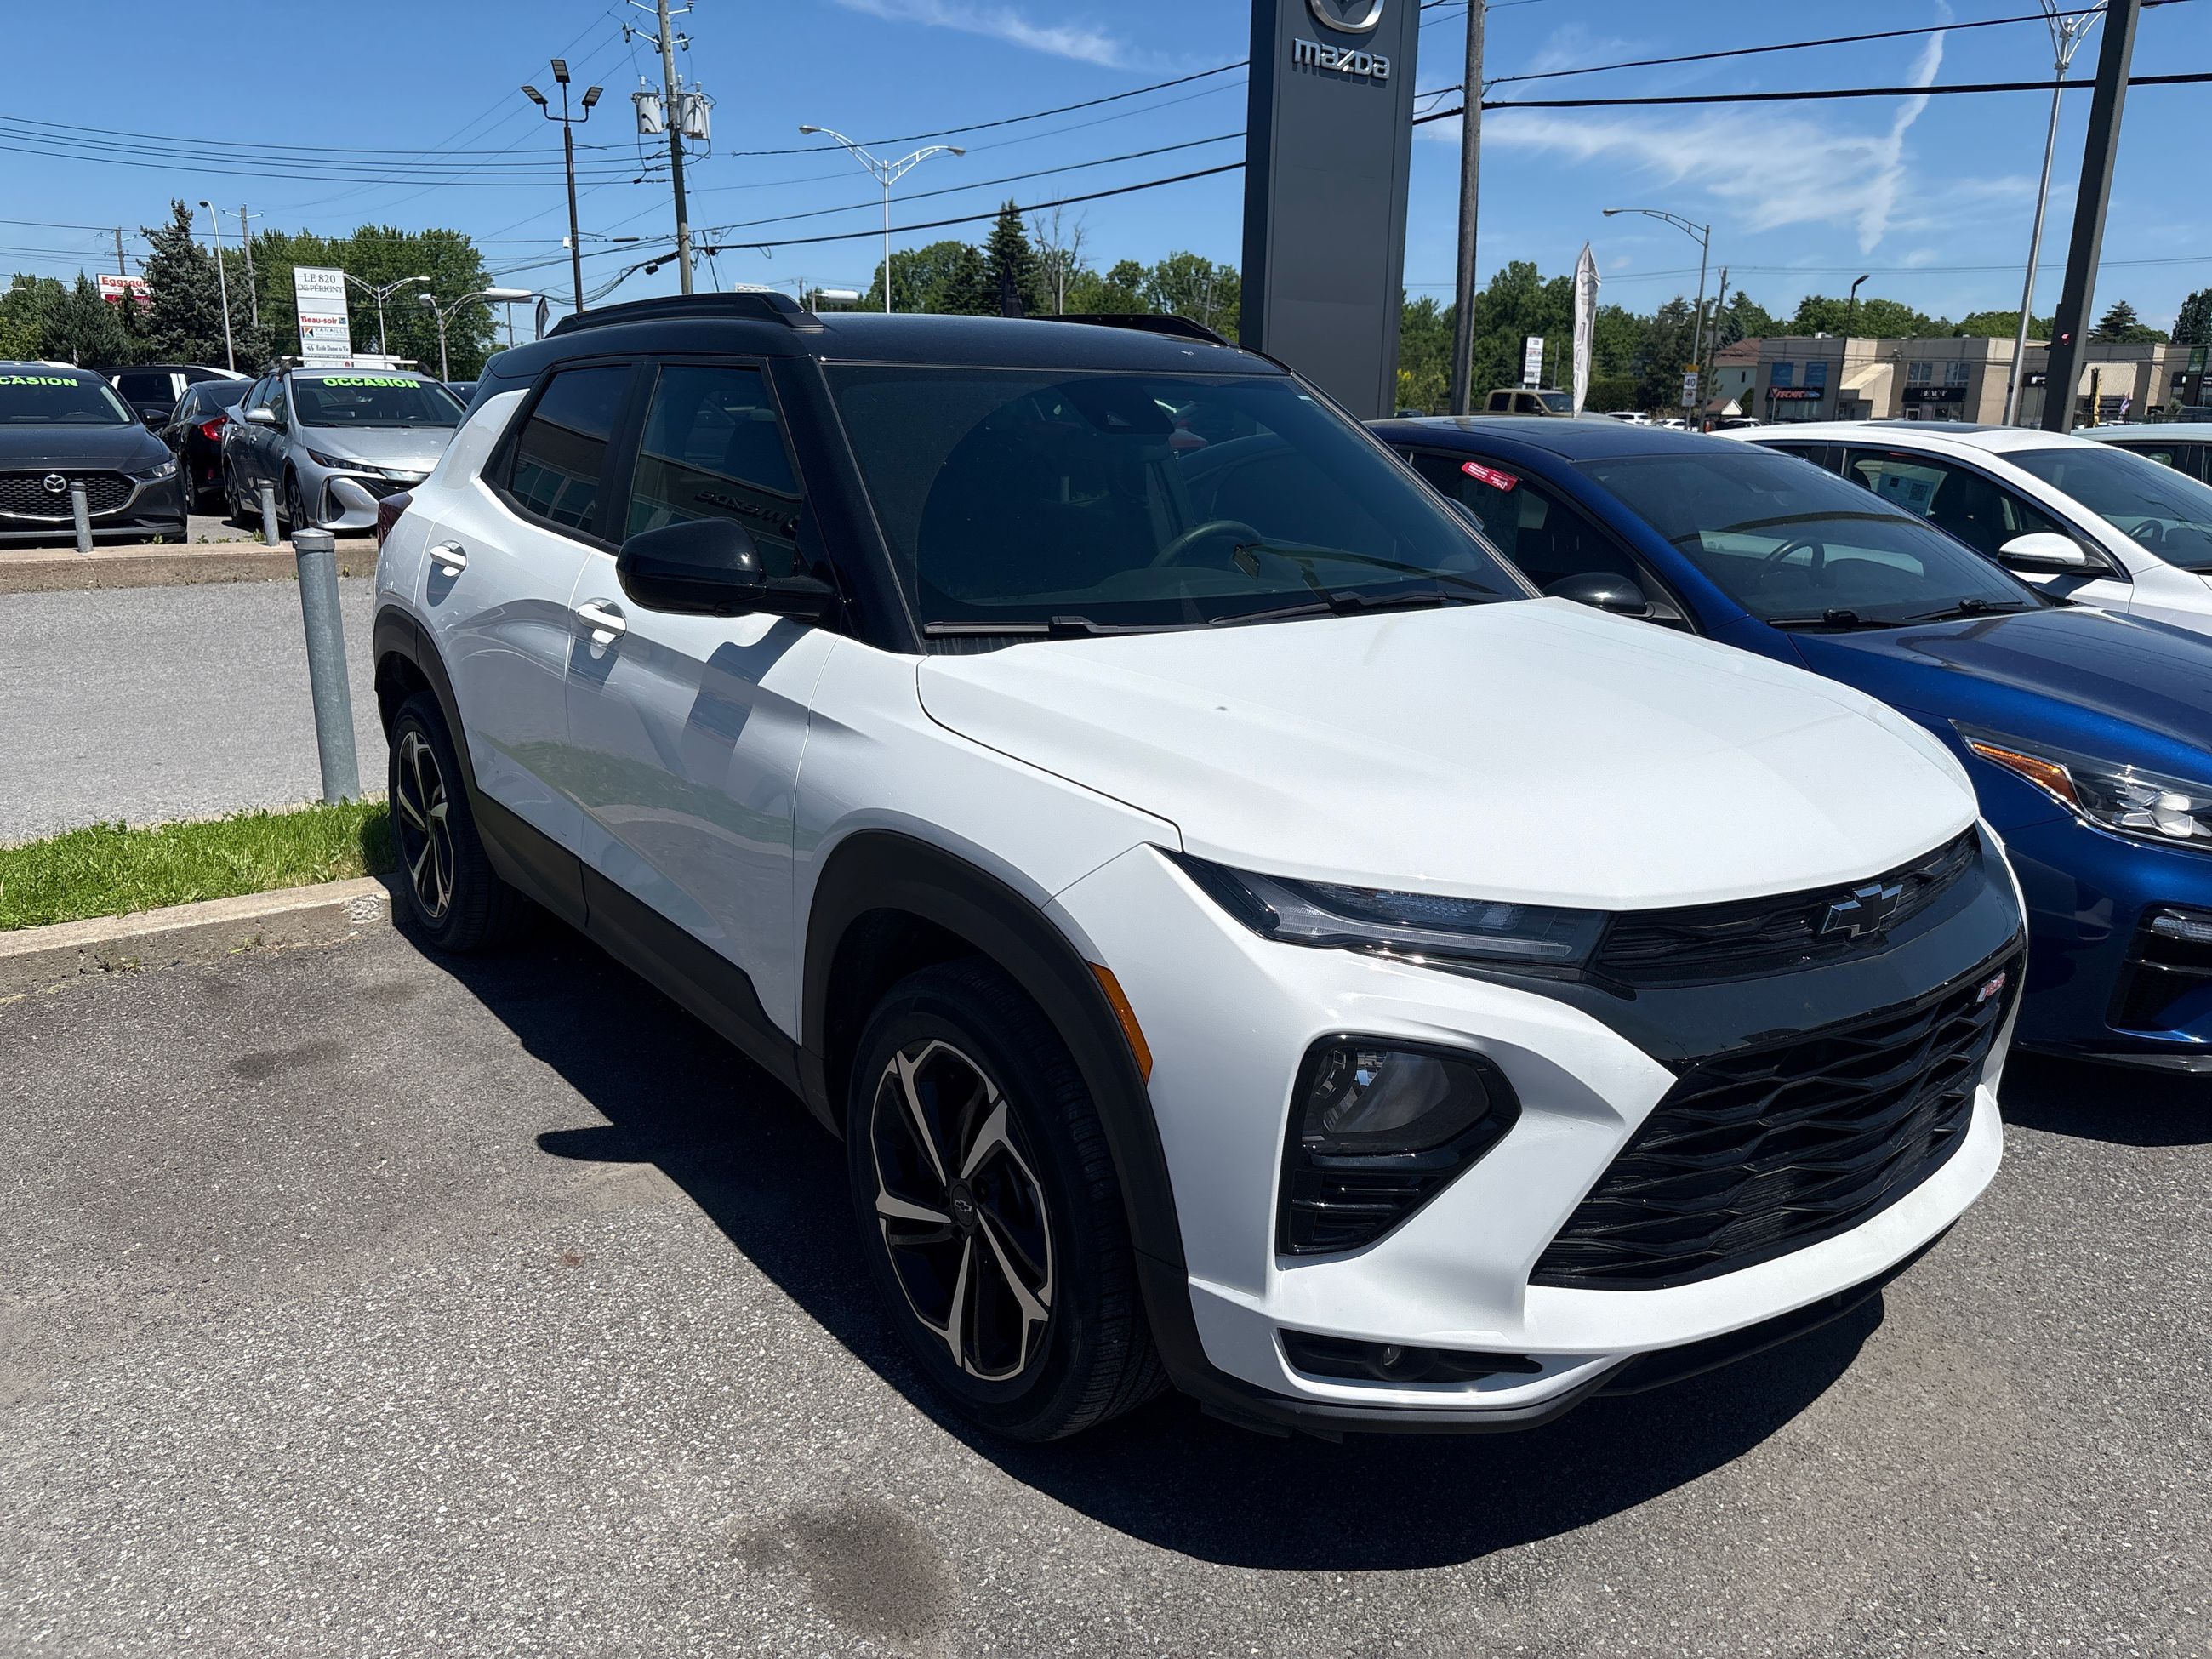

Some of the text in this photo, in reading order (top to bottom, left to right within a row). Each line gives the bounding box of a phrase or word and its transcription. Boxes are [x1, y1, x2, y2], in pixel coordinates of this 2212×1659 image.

[1292, 37, 1390, 79] mazda
[304, 273, 336, 283] LE 820
[310, 283, 344, 293] PÉRIGNY
[300, 316, 338, 324] Beau-soir
[322, 378, 421, 389] OCCASION
[1685, 378, 1696, 387] 40
